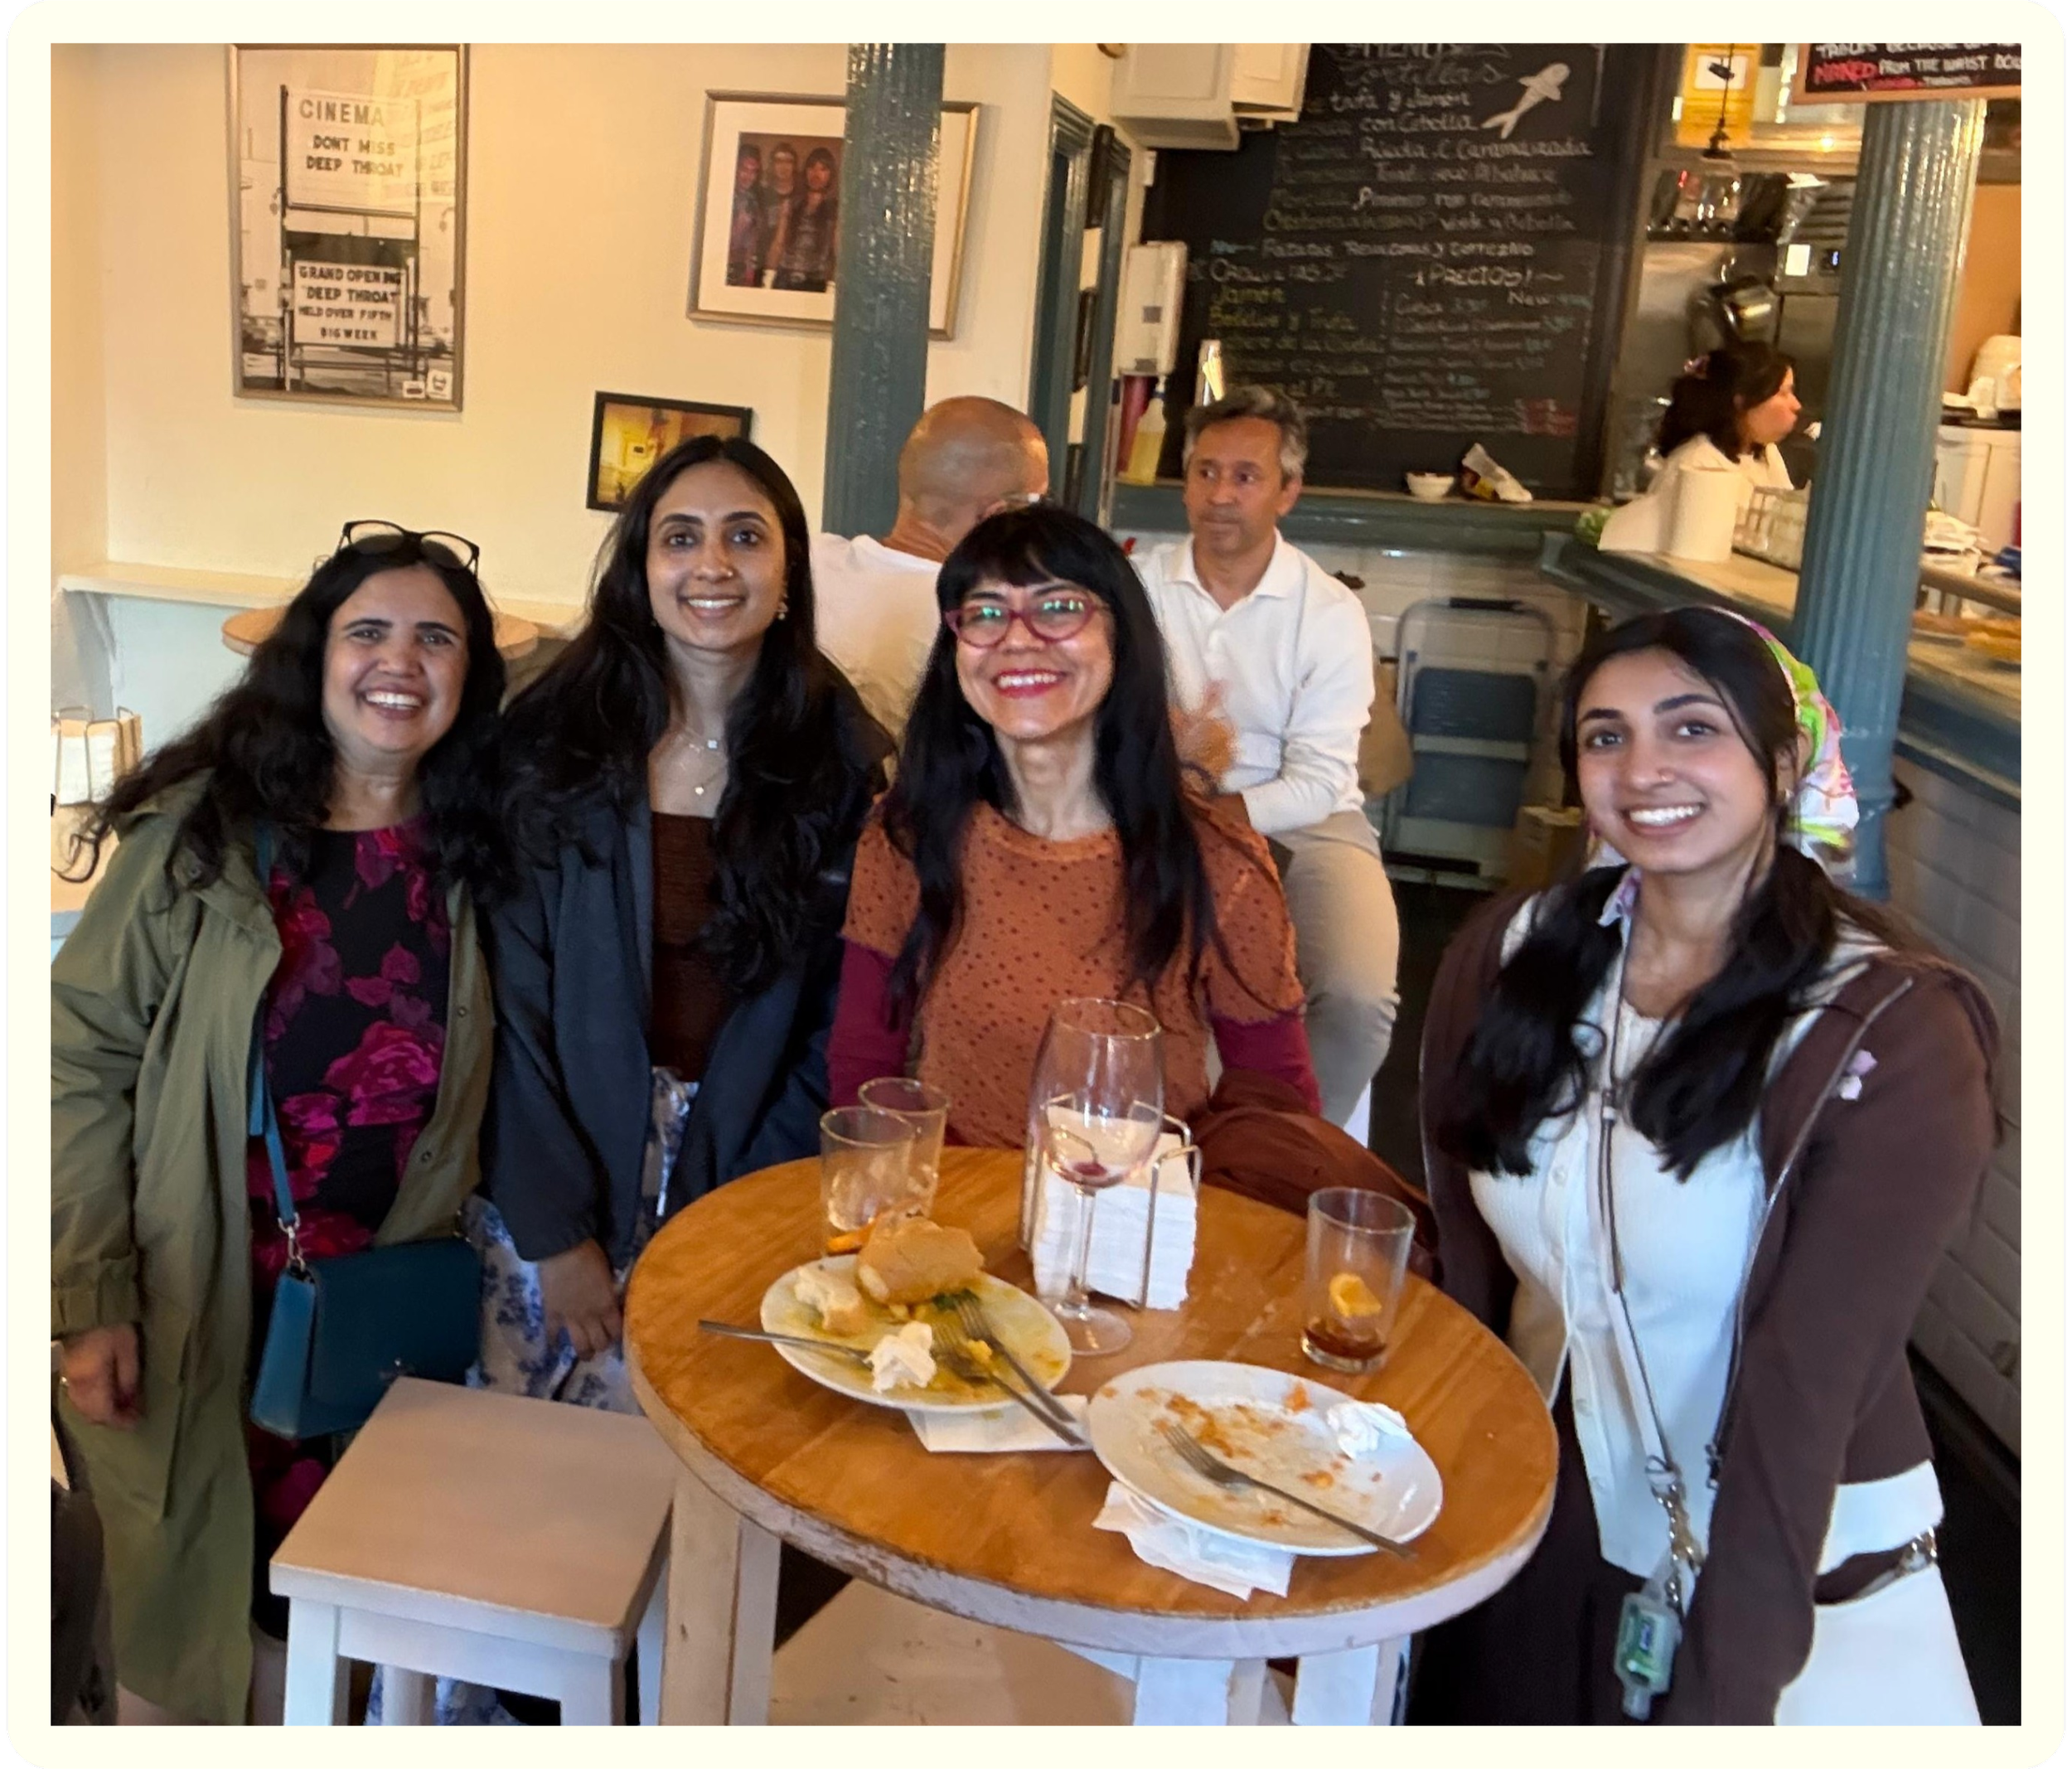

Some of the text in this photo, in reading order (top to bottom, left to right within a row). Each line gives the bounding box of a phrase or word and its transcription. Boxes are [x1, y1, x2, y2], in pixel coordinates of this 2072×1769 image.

[1914, 56, 1939, 72] THE
[299, 99, 385, 126] CINEMA
[312, 134, 395, 157] DONT MISS
[306, 155, 404, 178] DEEP THROAT
[299, 265, 344, 281] GRAND
[307, 286, 400, 304] DEEP THROAT
[298, 306, 392, 321] HELD OVER FIFTH
[343, 329, 377, 340] WEEK
